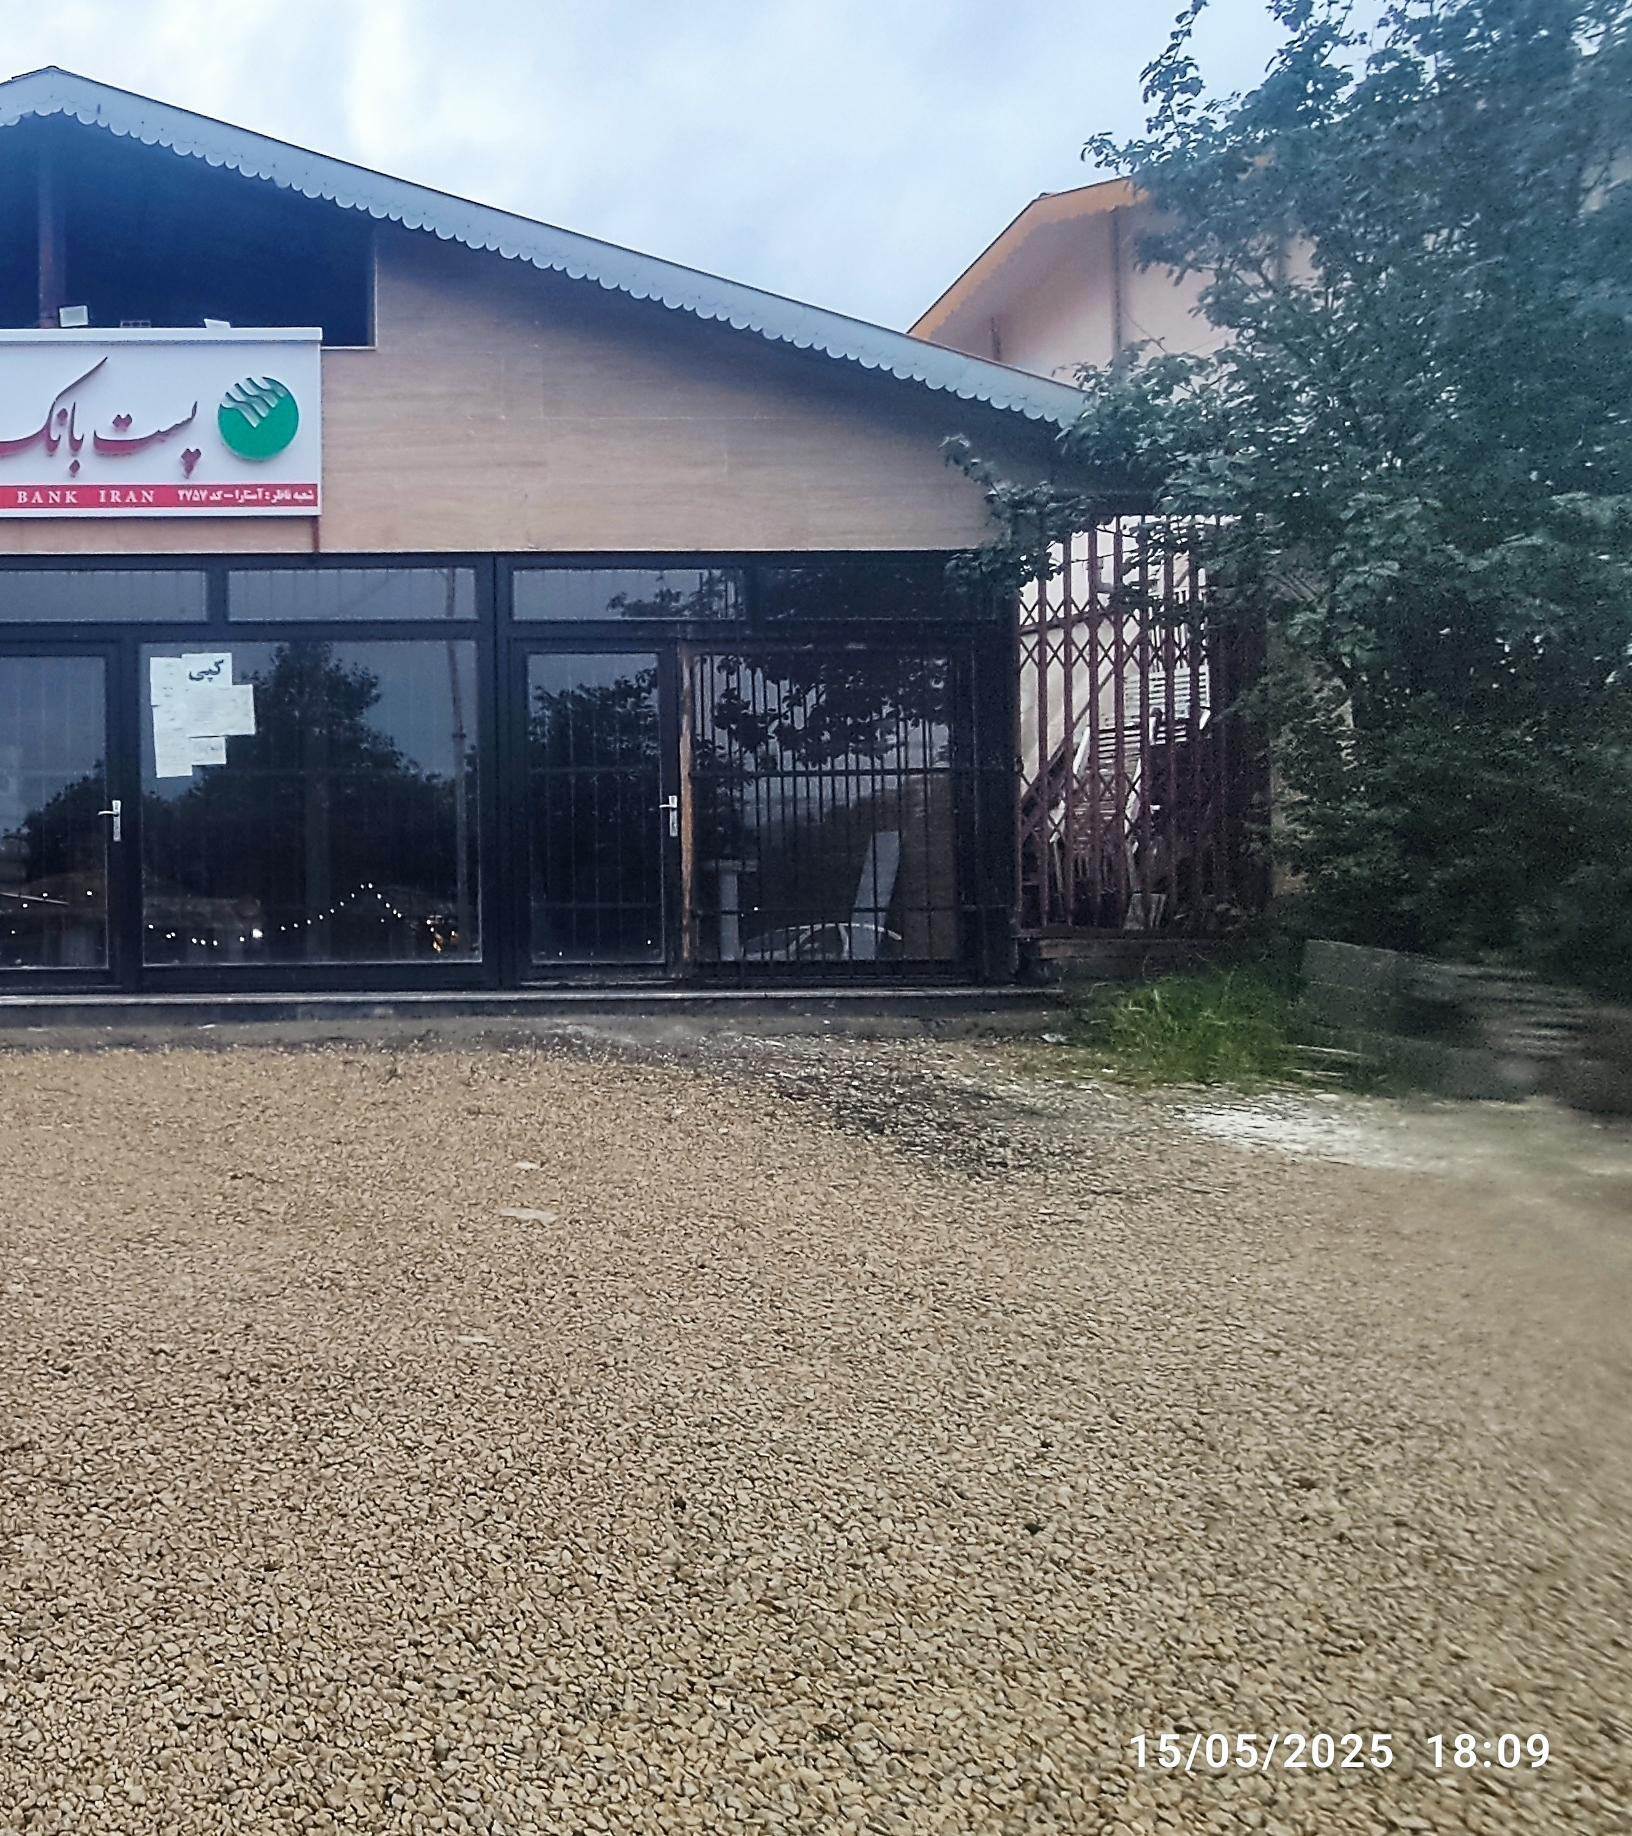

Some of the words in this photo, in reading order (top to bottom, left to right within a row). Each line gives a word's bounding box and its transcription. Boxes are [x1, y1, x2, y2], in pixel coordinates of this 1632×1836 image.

[92, 400, 202, 479] پست
[16, 490, 79, 504] BANK
[99, 489, 156, 504] IRAN
[235, 487, 264, 503] آستارا
[188, 658, 225, 683] کپی
